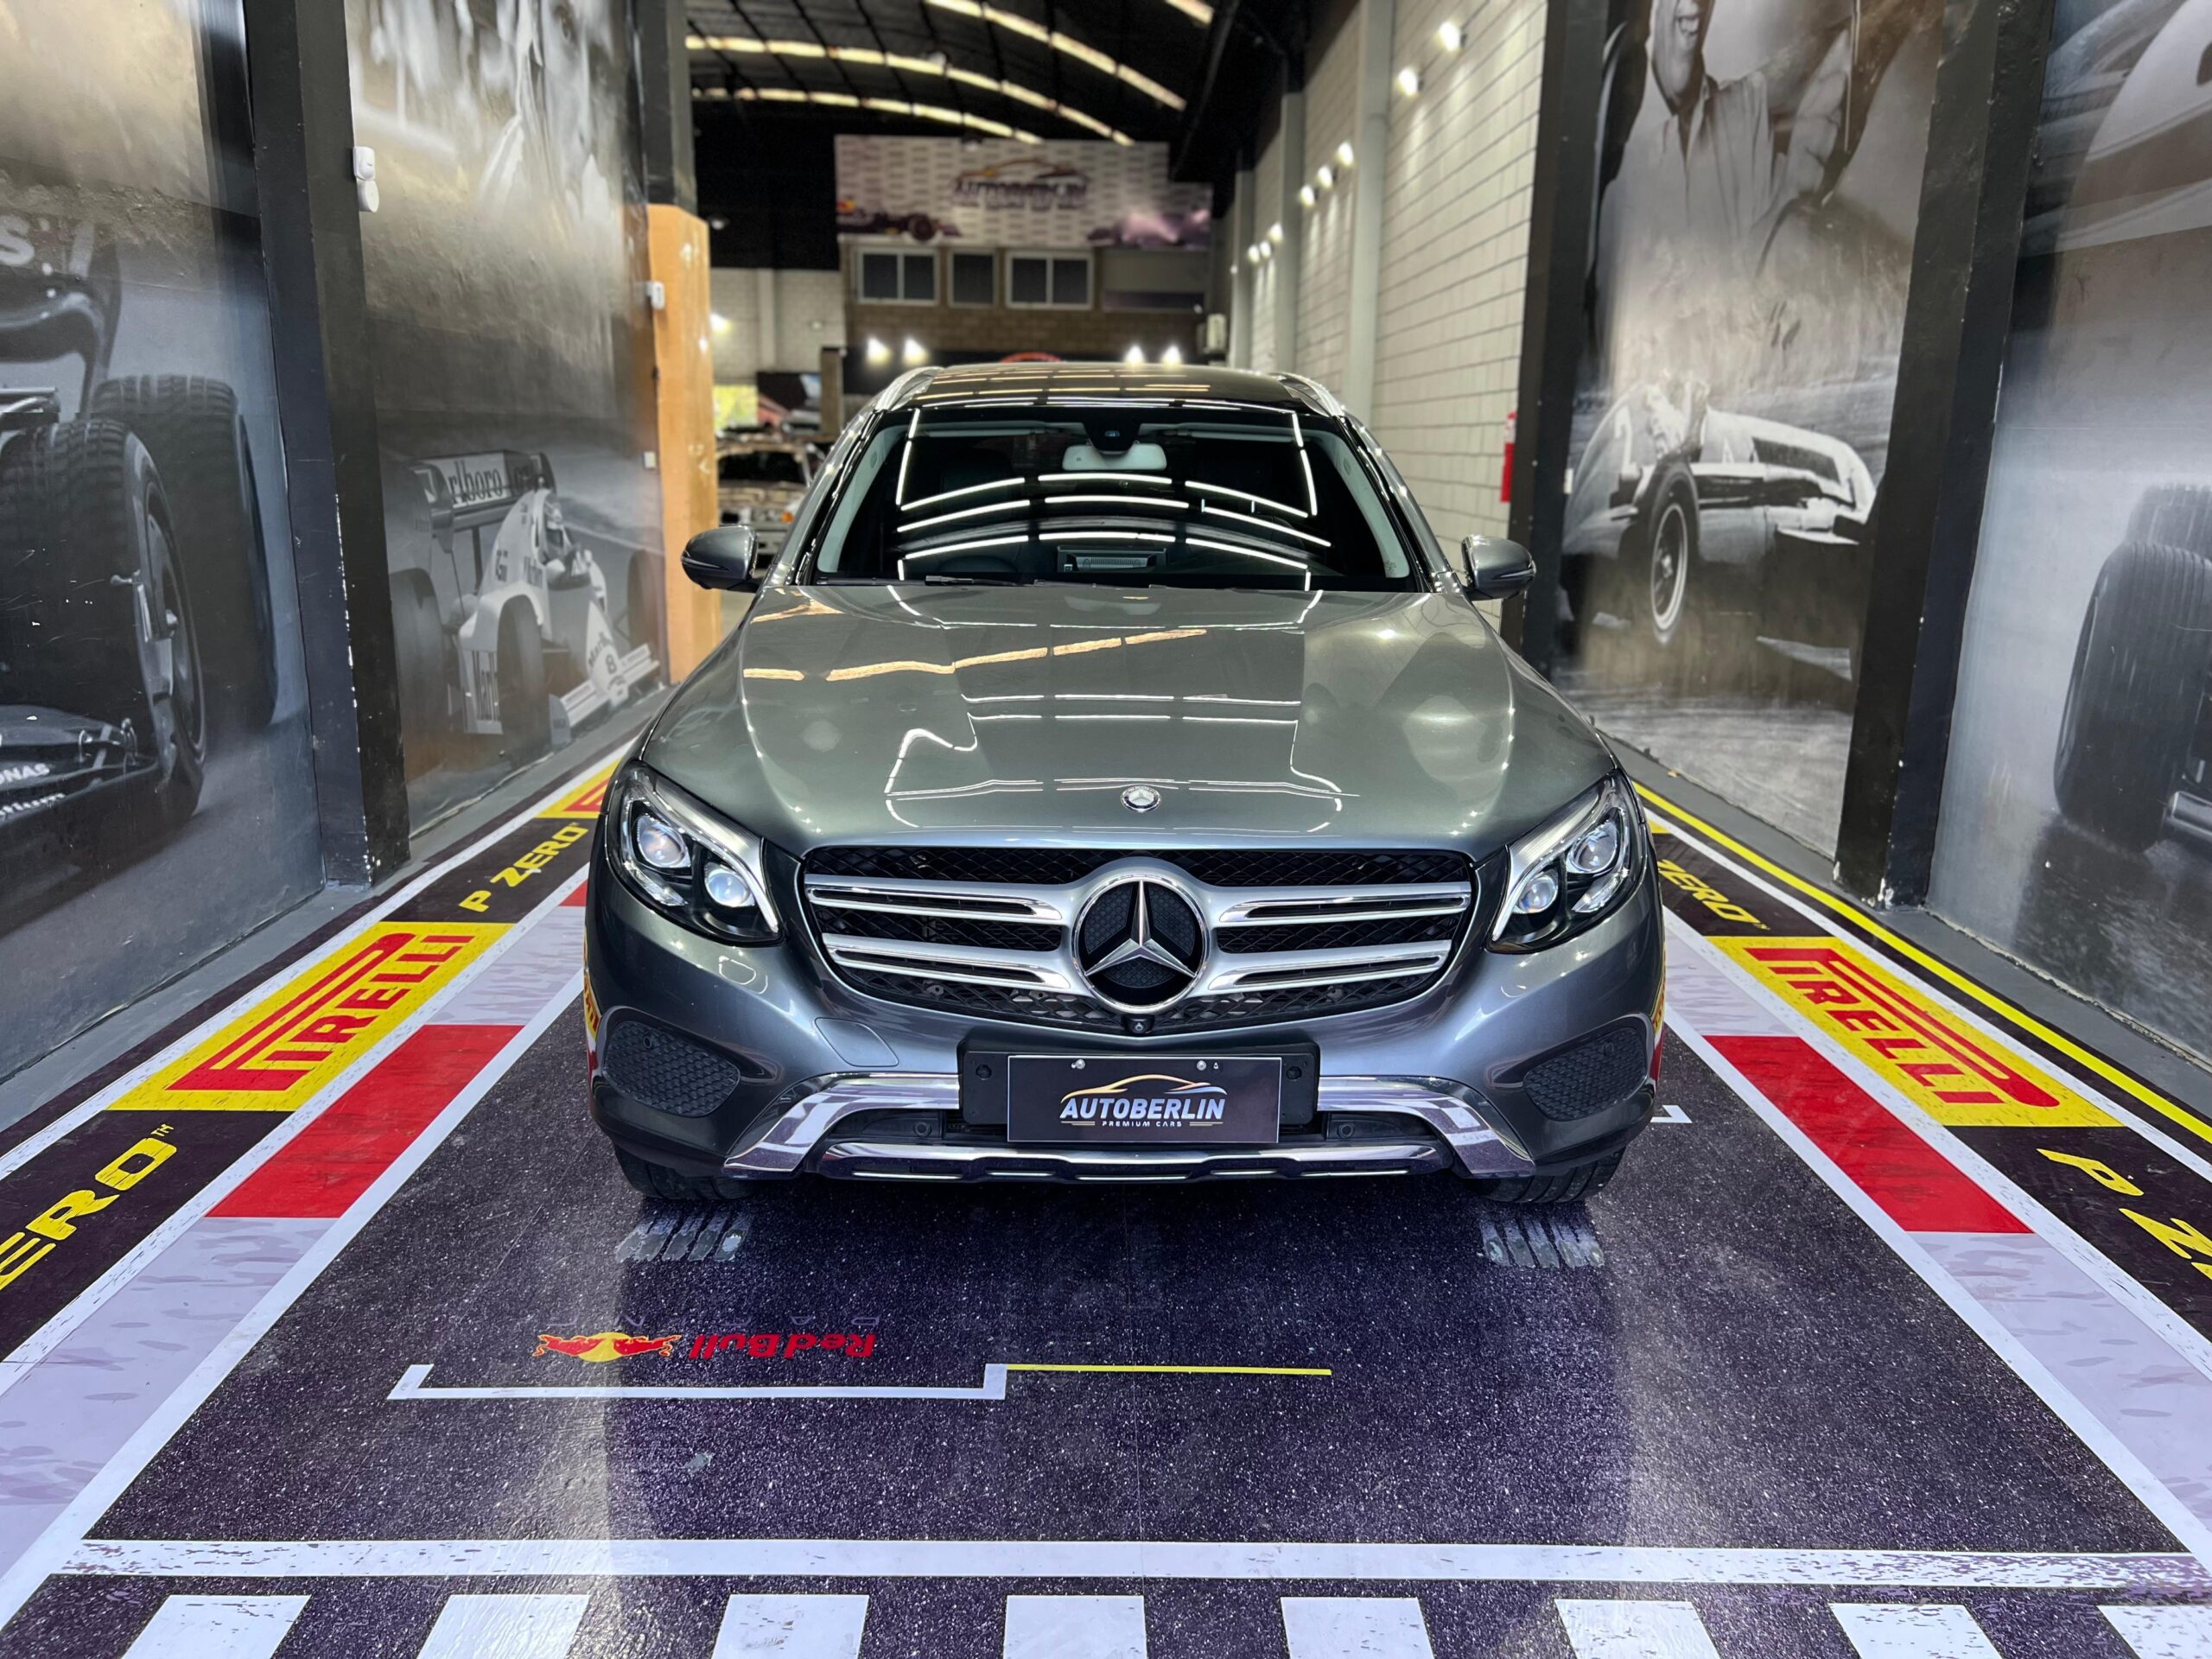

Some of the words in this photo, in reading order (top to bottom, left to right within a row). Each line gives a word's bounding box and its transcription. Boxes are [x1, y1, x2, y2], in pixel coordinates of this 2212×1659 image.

[448, 458, 504, 501] rlboro
[459, 890, 492, 912] P
[164, 932, 475, 1091] PIRELLI
[1742, 947, 2060, 1108] PIRELLI
[1059, 1098, 1225, 1120] AUTOBERLIN
[2036, 1147, 2145, 1197] P
[2119, 1208, 2212, 1281] Z
[689, 1333, 779, 1359] Bull
[785, 1333, 877, 1359] Red
